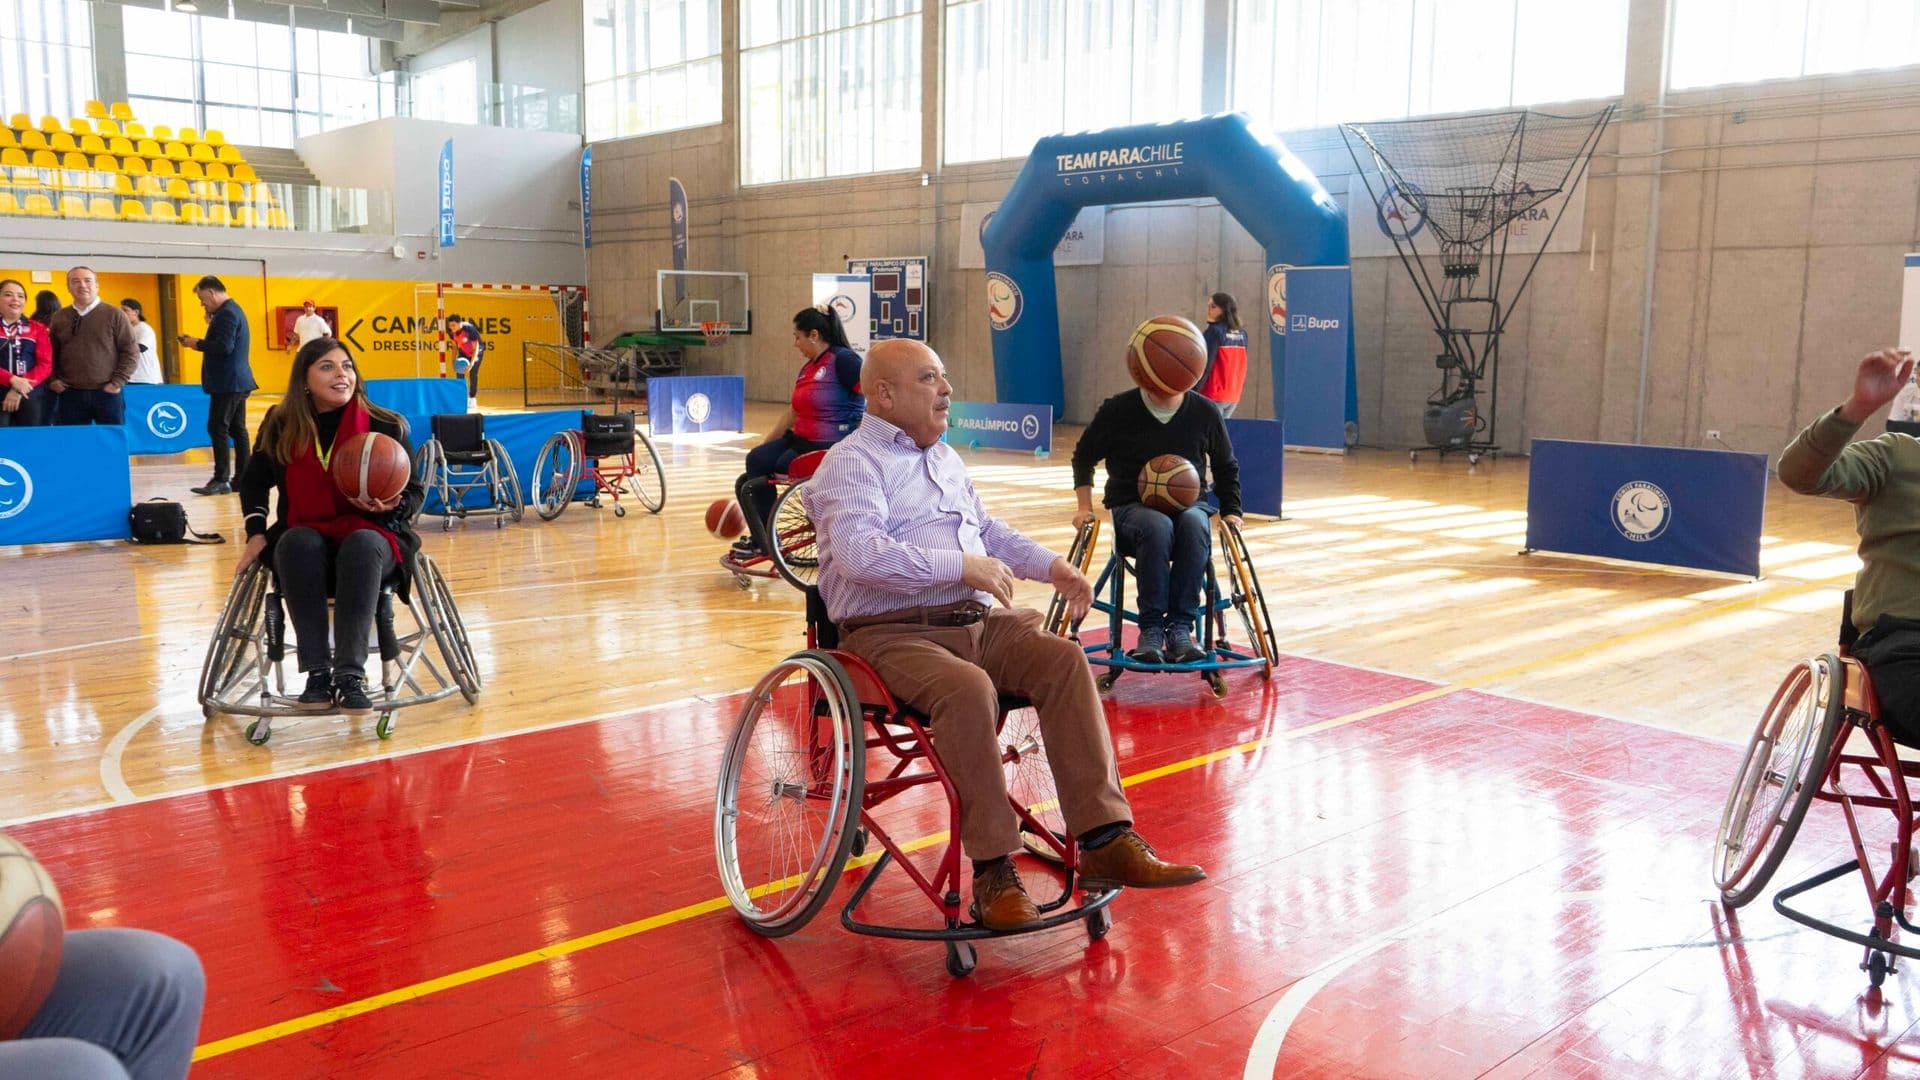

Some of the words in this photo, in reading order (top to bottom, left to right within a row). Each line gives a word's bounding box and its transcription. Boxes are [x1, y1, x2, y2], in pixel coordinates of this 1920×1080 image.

[1056, 152, 1096, 171] TEAM
[443, 159, 452, 209] Bupa
[1064, 231, 1085, 241] ARA
[1308, 317, 1340, 330] Bupa
[958, 417, 1019, 432] PARALÍMPICO
